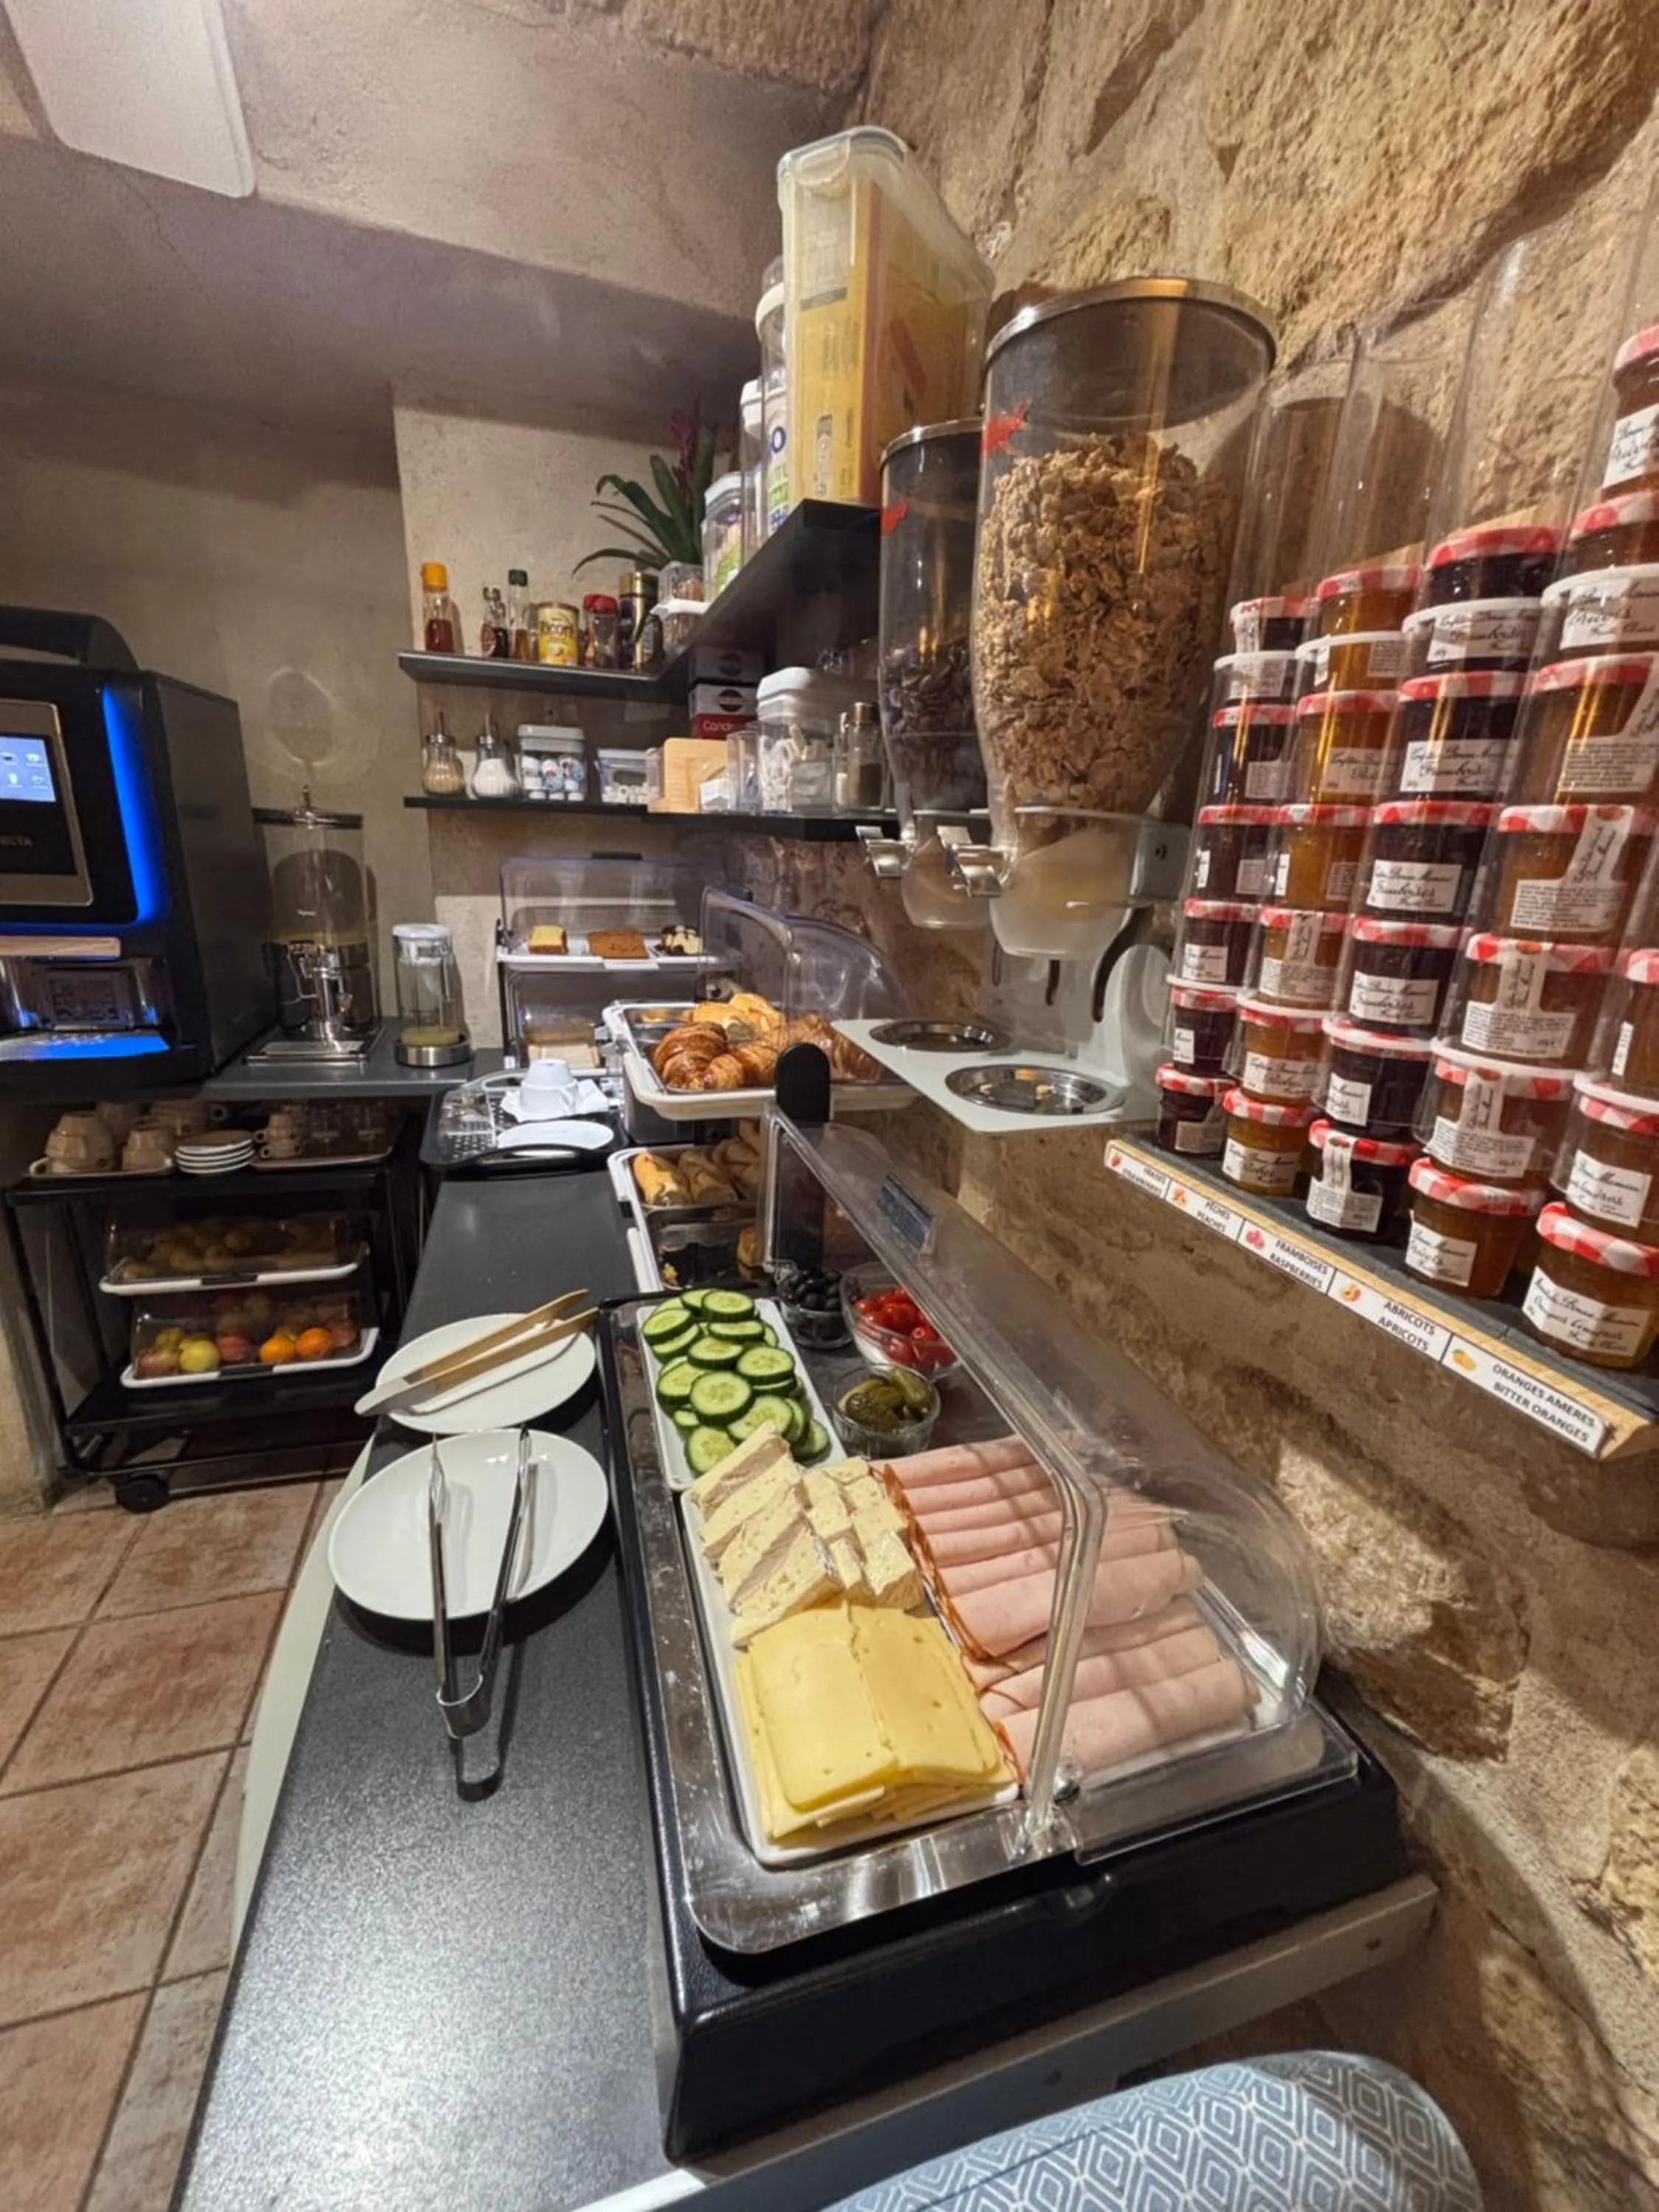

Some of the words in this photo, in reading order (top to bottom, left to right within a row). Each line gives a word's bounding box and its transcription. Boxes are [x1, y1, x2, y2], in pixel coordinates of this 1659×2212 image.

[1269, 1252, 1324, 1289] RASPBERRIES
[1275, 1238, 1328, 1276] FRAMBOISES
[1377, 1316, 1429, 1352] APRICOTS
[1383, 1300, 1436, 1337] ABRICOTS
[1492, 1363, 1546, 1399] ORANGES
[1493, 1381, 1530, 1408] BITTER
[1531, 1402, 1590, 1443] ORANGES
